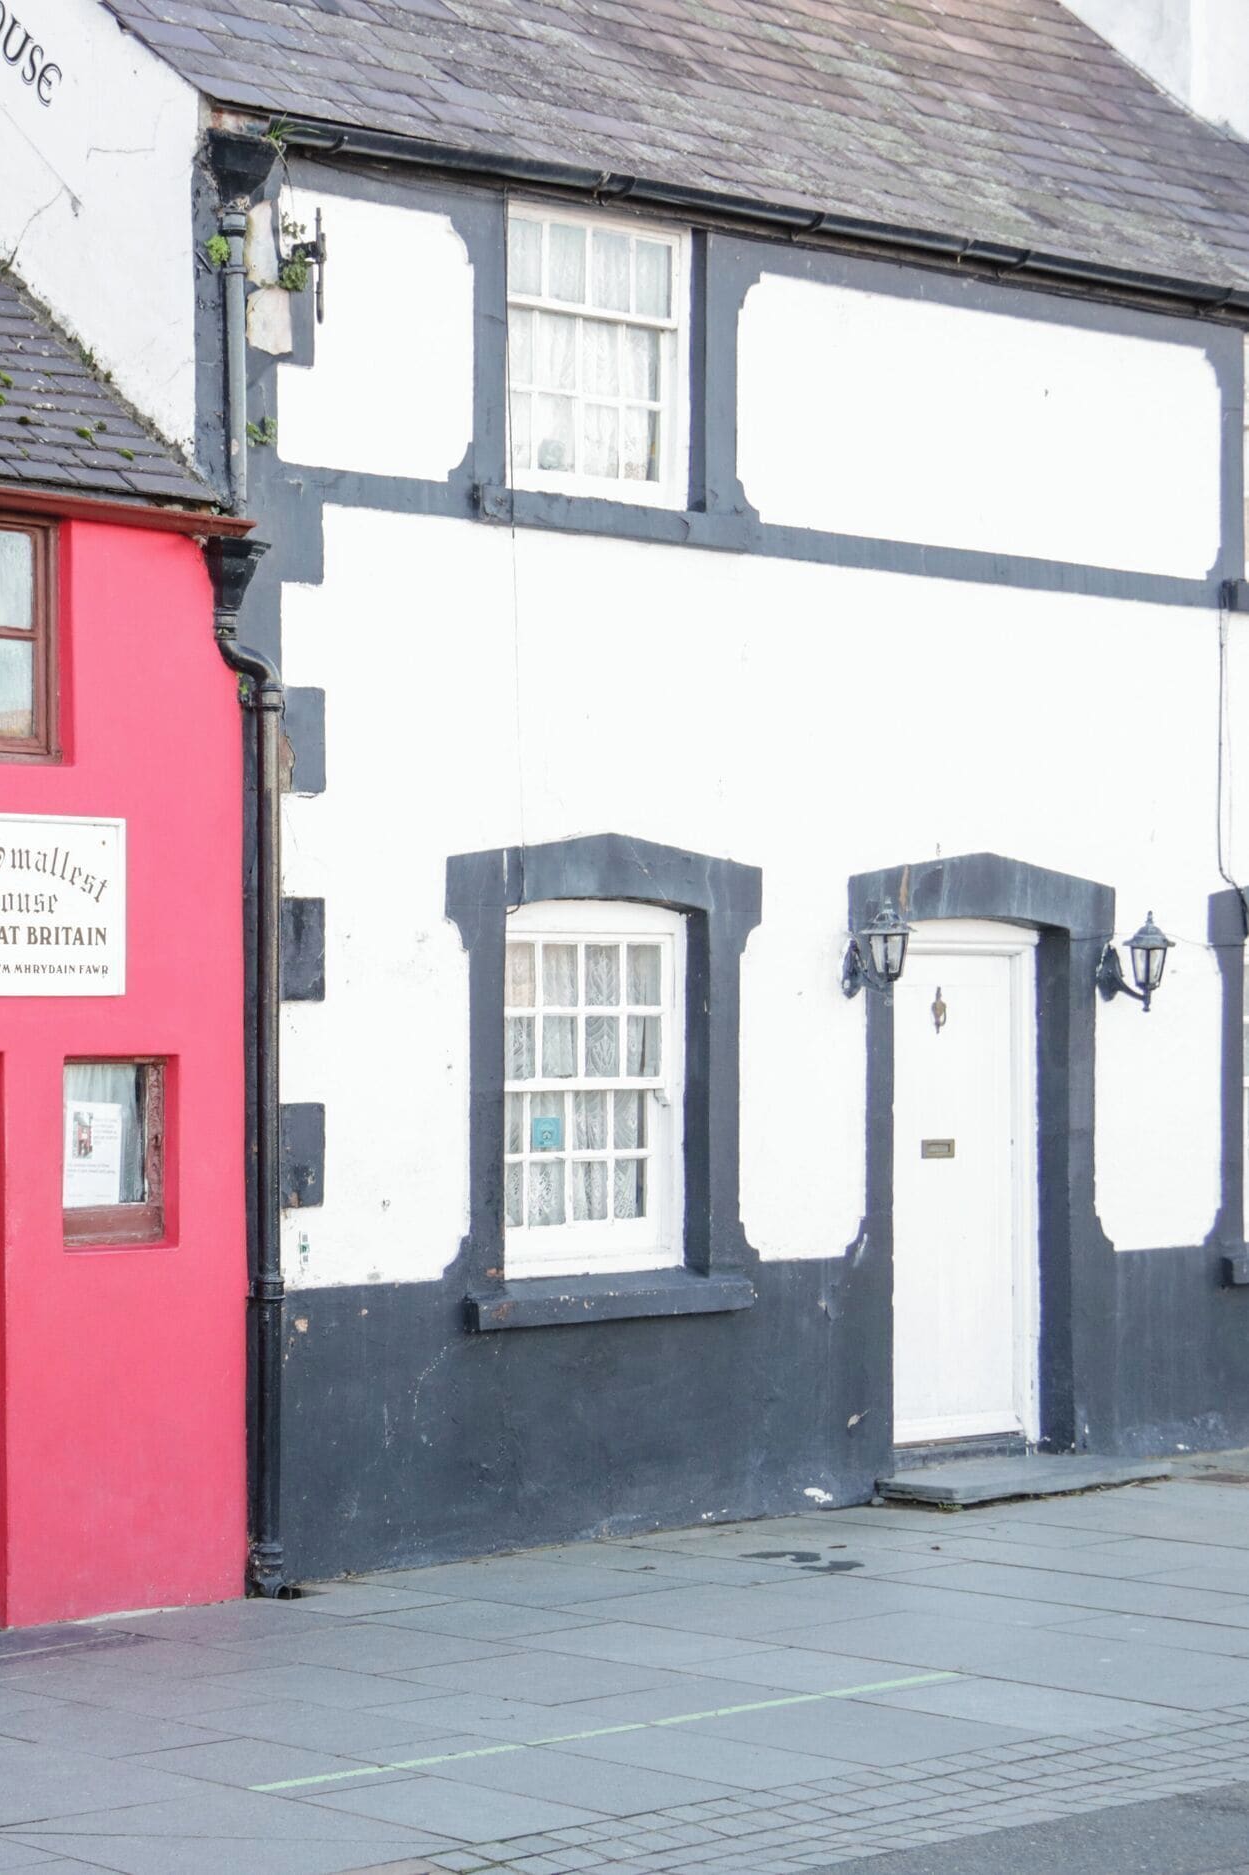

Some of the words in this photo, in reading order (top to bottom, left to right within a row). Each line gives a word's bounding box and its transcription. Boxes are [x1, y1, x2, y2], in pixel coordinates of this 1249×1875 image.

[27, 926, 107, 946] BRITAIN
[14, 964, 76, 975] MHRYDAIN
[79, 965, 109, 976] FAWR
